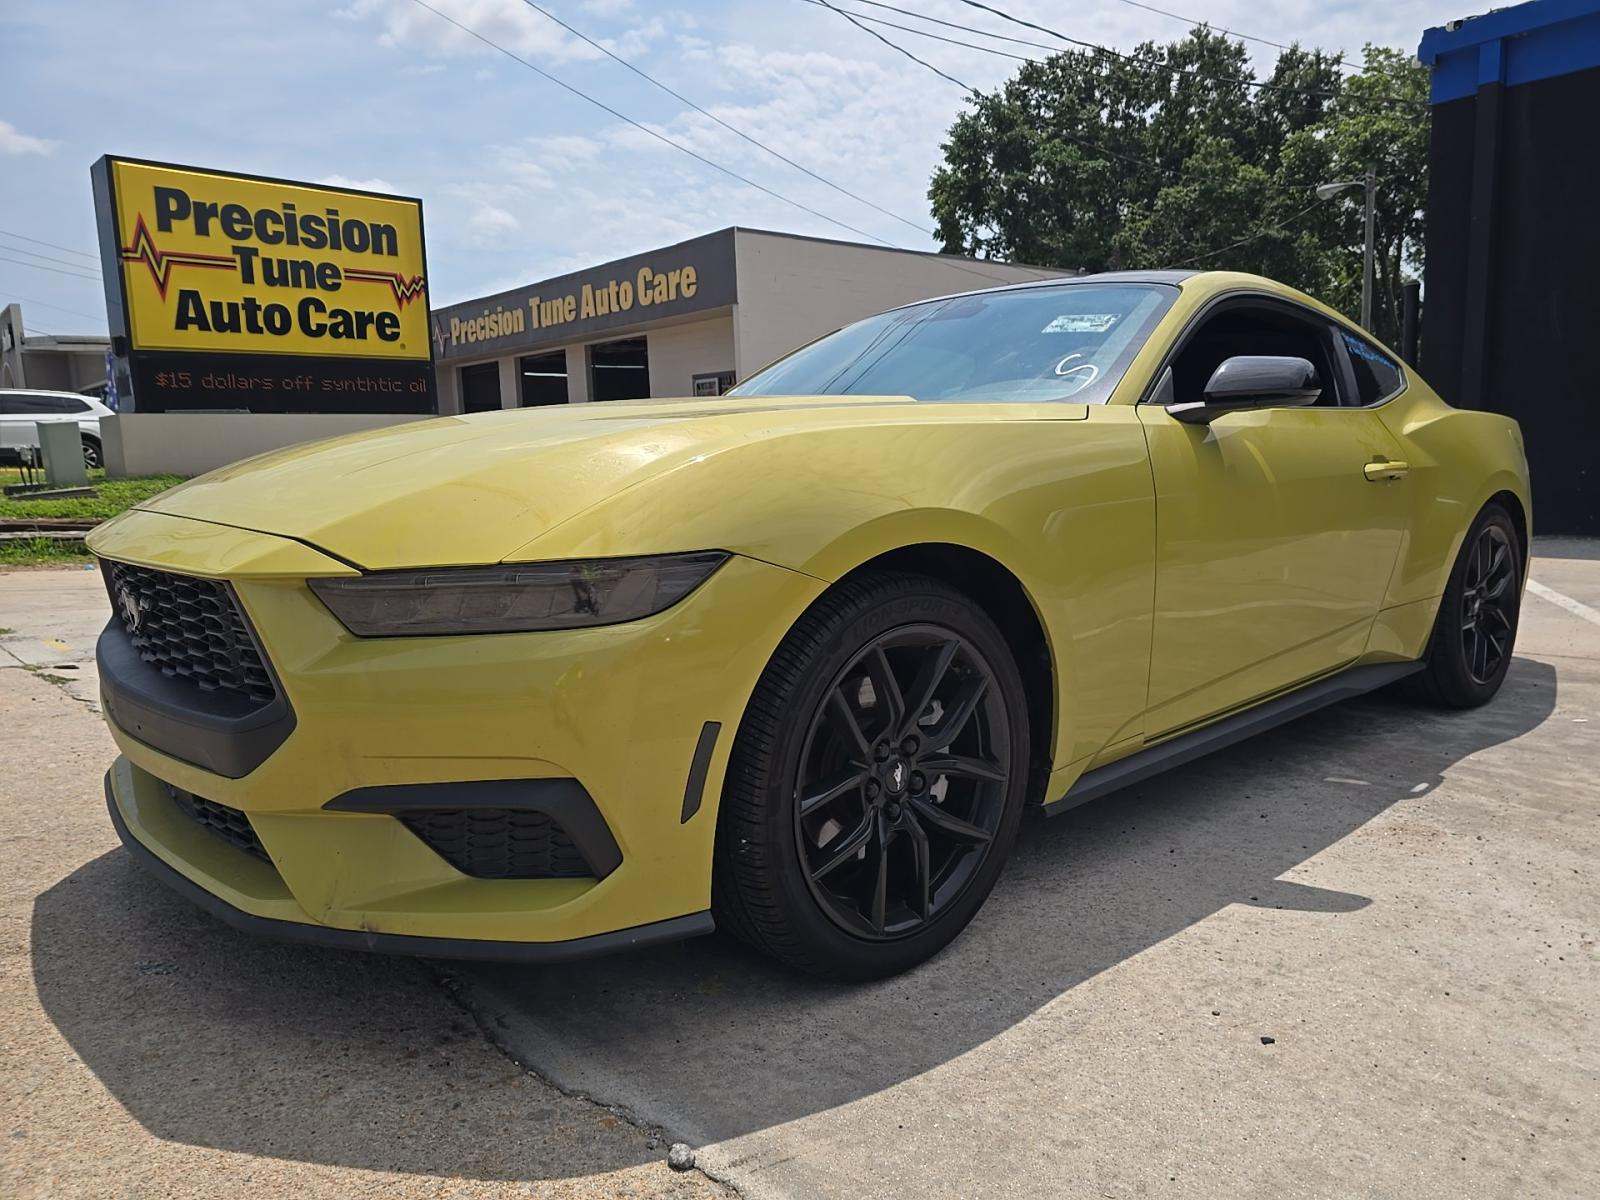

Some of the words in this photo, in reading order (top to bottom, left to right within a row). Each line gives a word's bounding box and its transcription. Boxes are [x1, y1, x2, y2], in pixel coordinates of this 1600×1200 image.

[154, 187, 398, 256] Precision
[232, 245, 342, 292] Tune
[174, 289, 292, 335] Auto
[297, 297, 401, 341] Care
[451, 307, 524, 345] Precision
[529, 295, 577, 329] Tune
[581, 279, 634, 320] Auto
[636, 265, 698, 307] Care
[154, 371, 193, 390] $15
[200, 372, 274, 391] dollars
[281, 375, 314, 391] off
[320, 376, 402, 393] synthtic
[408, 376, 427, 394] oil
